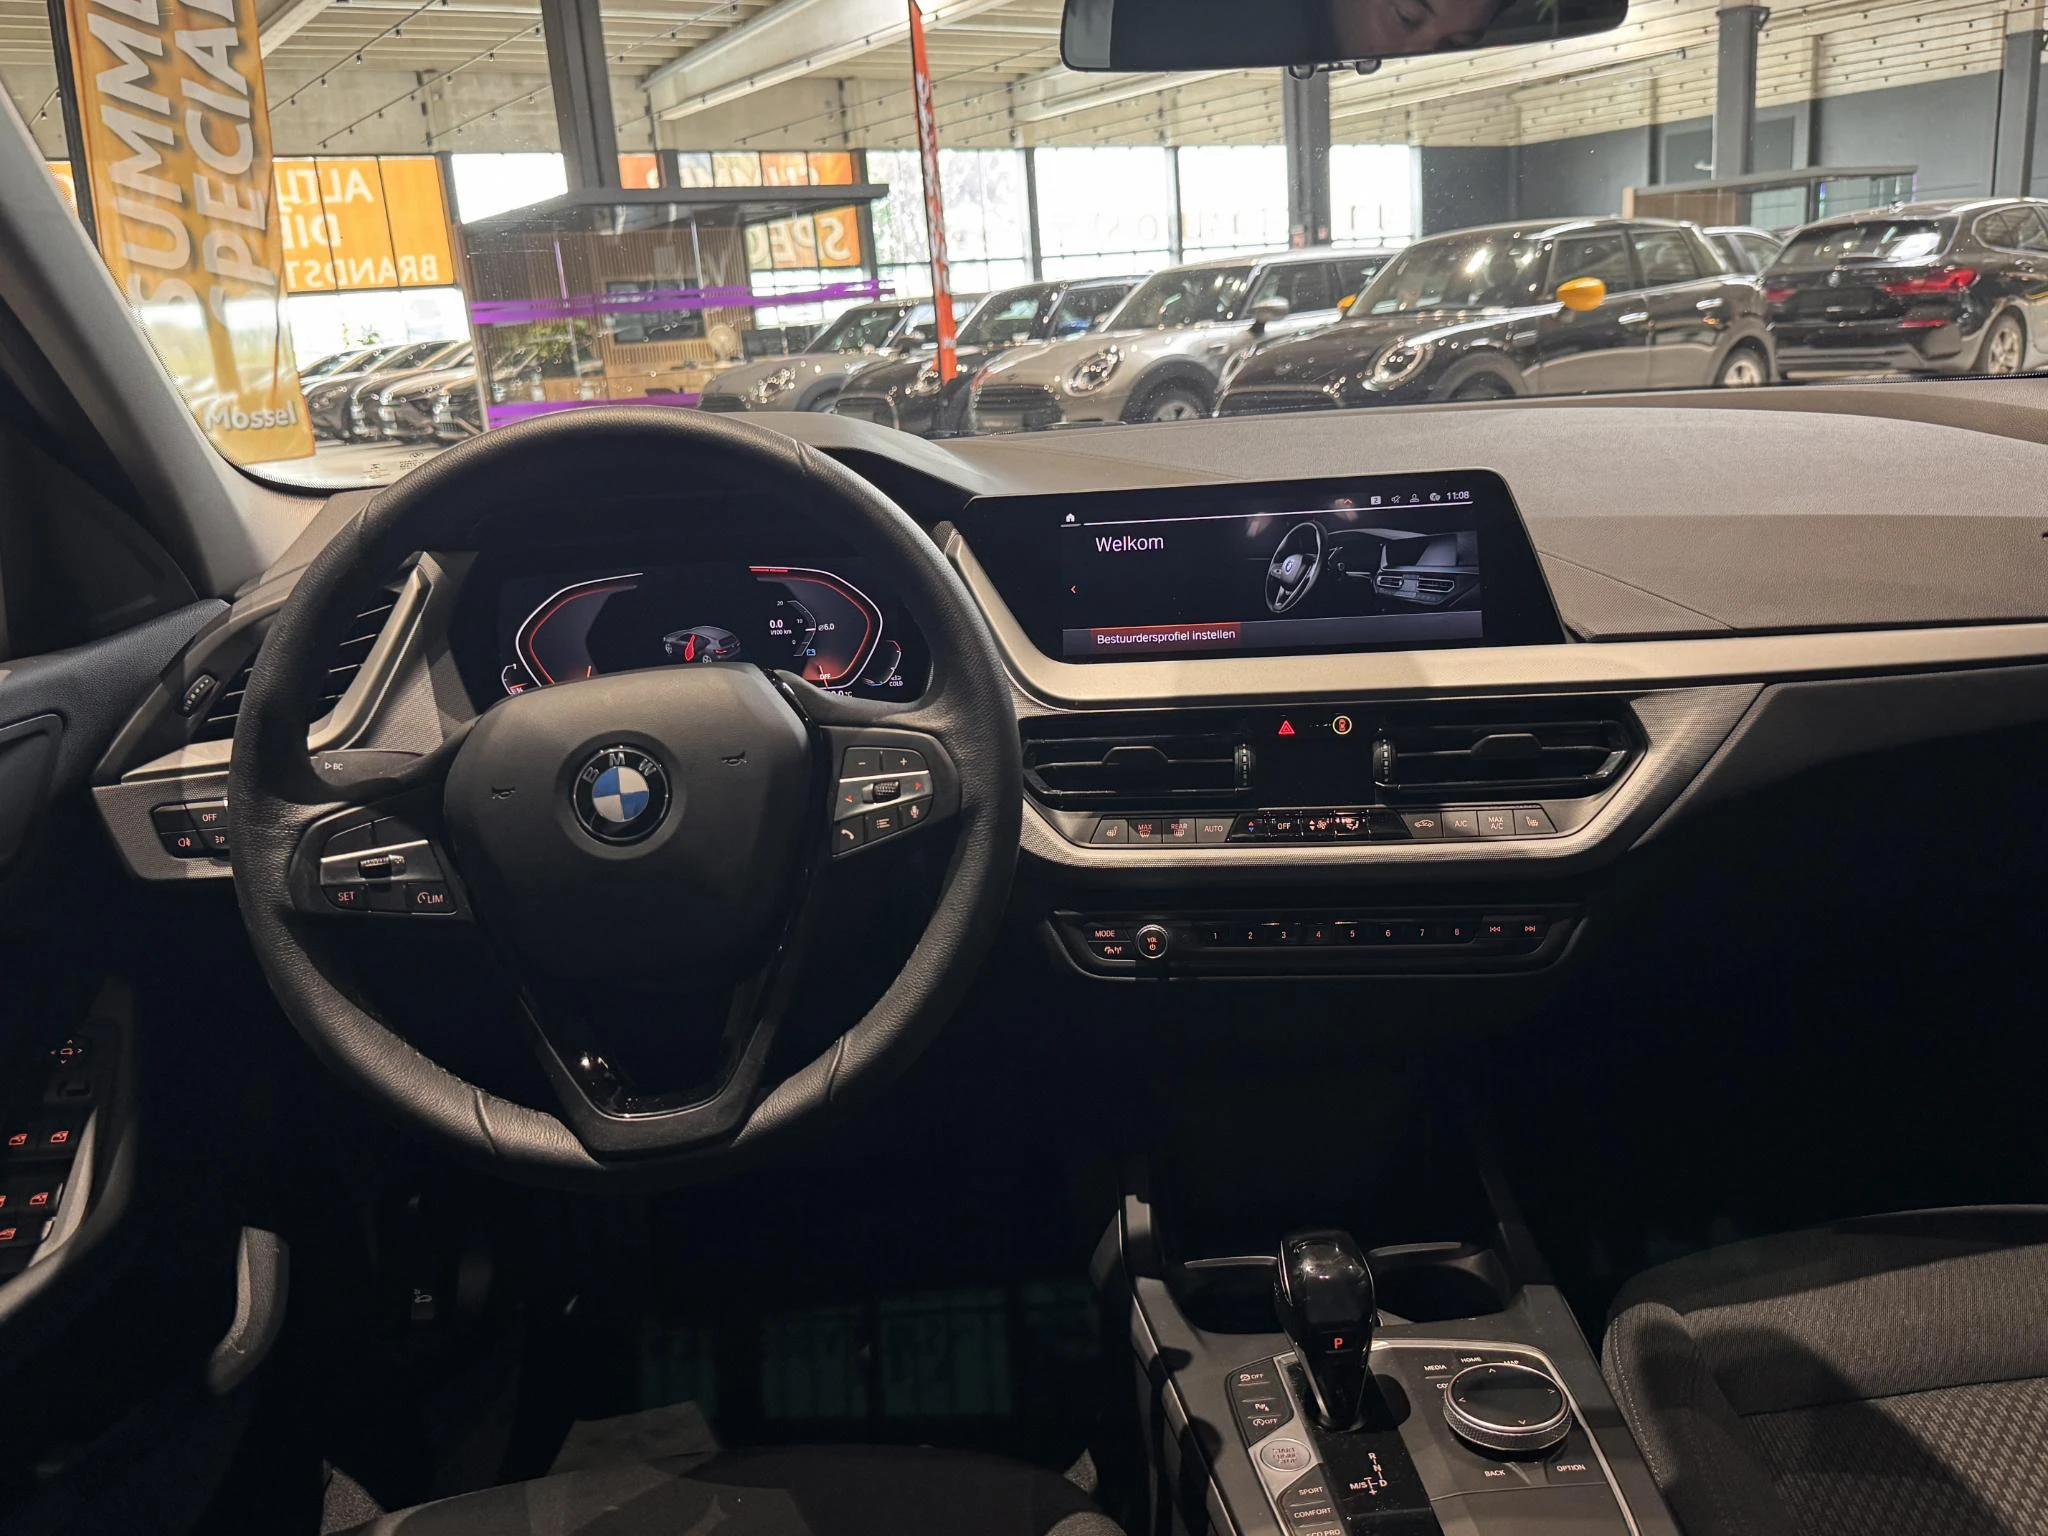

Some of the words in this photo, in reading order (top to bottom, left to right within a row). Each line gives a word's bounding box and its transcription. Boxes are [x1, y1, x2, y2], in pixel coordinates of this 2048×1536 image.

[203, 400, 299, 431] Mossel
[1446, 491, 1470, 500] 11:08
[1095, 535, 1164, 552] Welkom
[769, 619, 784, 629] 0.0
[1097, 631, 1190, 644] Bestuurdersprofiel
[1192, 629, 1236, 640] instellen
[582, 752, 657, 784] BMW
[202, 813, 217, 822] OFF
[1277, 822, 1291, 830] OFF
[338, 891, 356, 901] SET
[427, 894, 444, 904] LIM
[1334, 1337, 1343, 1349] P
[1368, 1452, 1376, 1460] R
[1373, 1464, 1382, 1472] N
[1484, 1469, 1506, 1477] BACK
[1556, 1464, 1586, 1472] OPTION
[1349, 1481, 1368, 1490] M/S
[1379, 1479, 1388, 1487] D
[1298, 1486, 1323, 1496] SPORT
[1294, 1507, 1332, 1519] COMFORT
